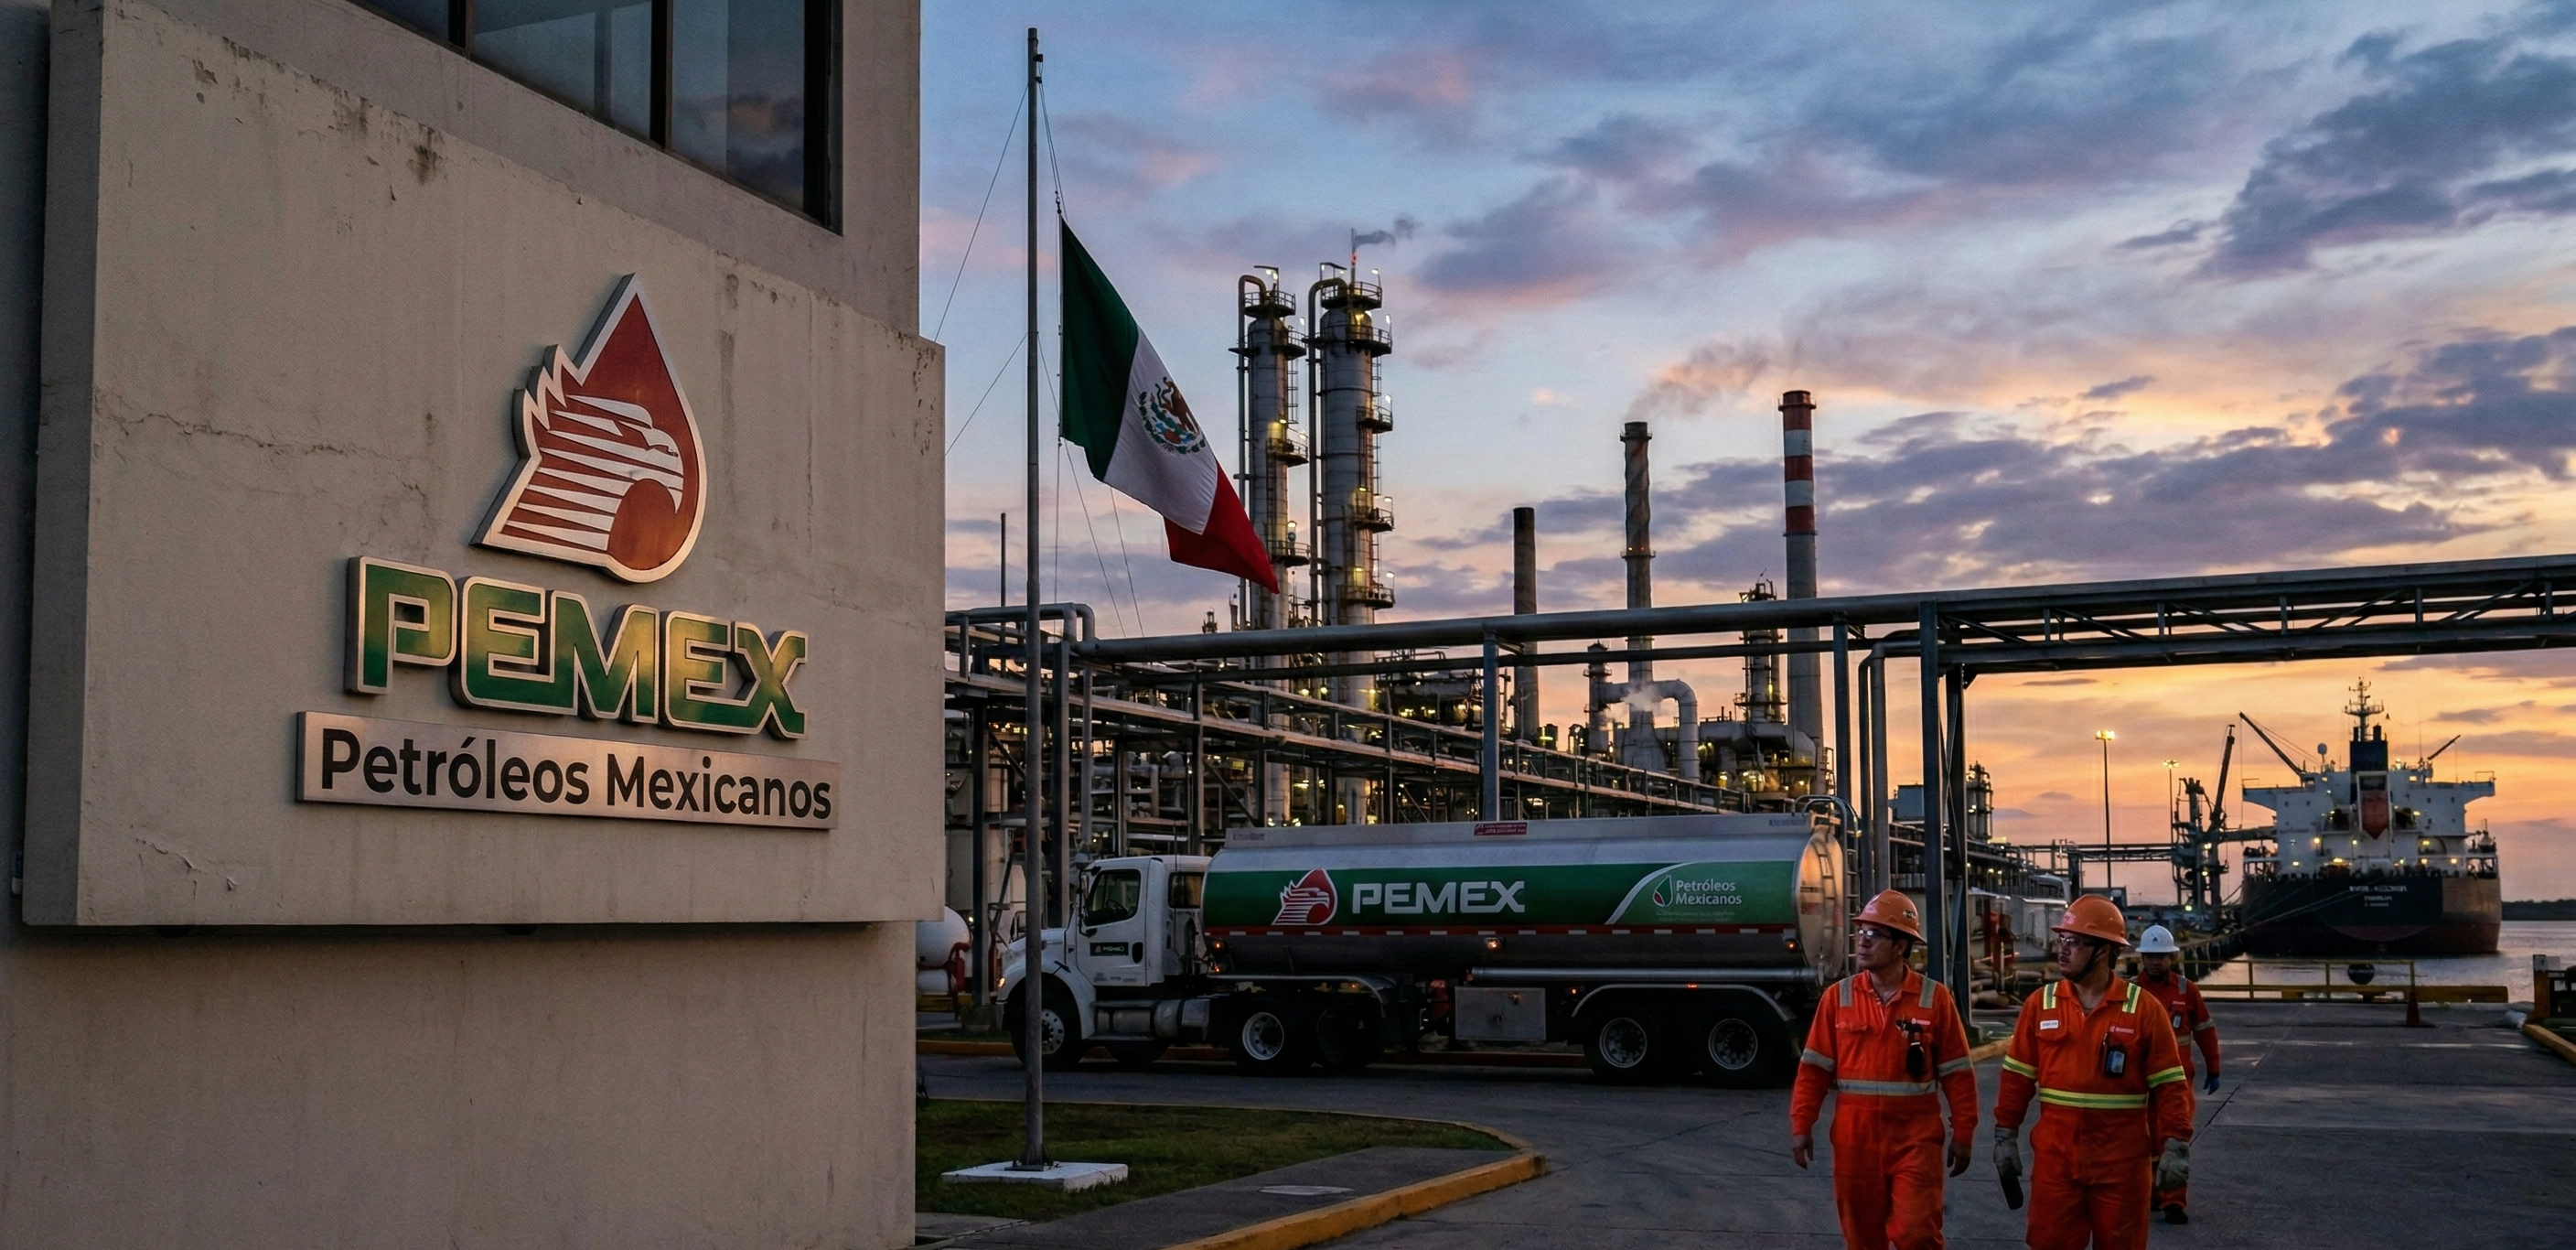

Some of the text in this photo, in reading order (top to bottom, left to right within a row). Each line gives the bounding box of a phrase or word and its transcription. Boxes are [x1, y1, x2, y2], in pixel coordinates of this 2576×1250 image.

[346, 555, 809, 739] PEMEX
[321, 728, 832, 820] Petróleos Mexicanos
[1352, 880, 1525, 914] PEMEX
[1675, 892, 1743, 905] Mexicanos
[1676, 878, 1736, 892] Petróleos
